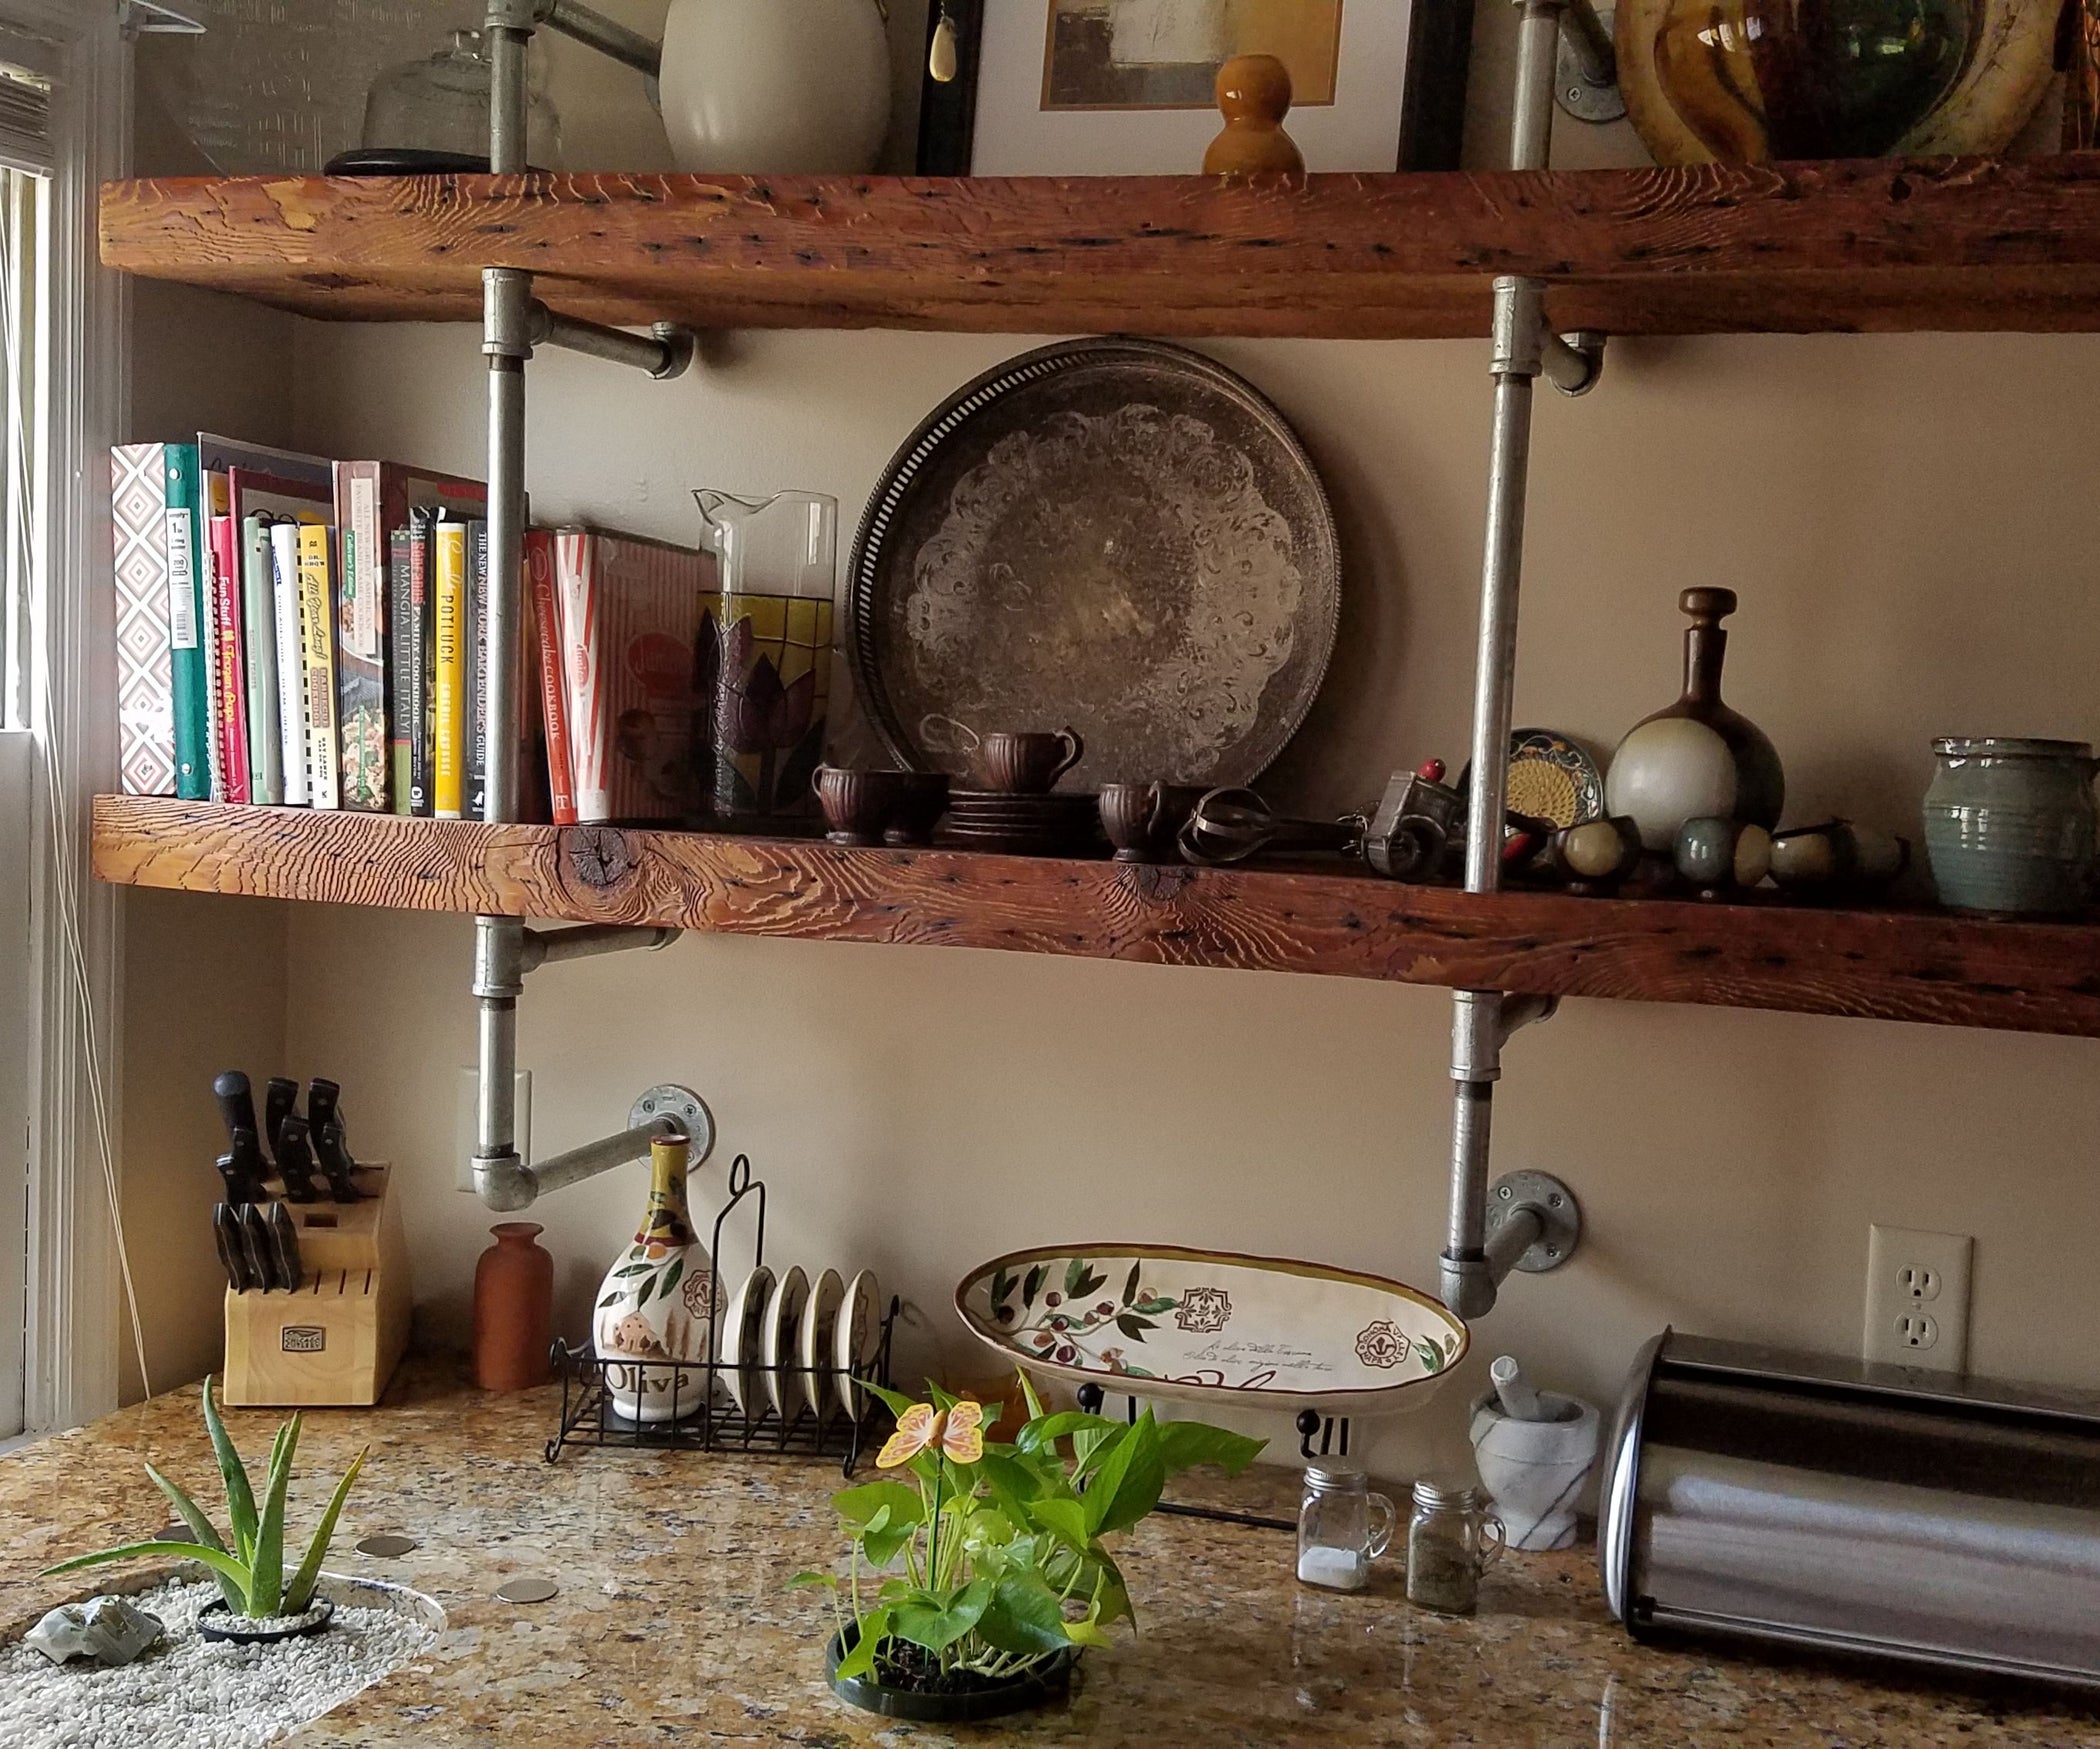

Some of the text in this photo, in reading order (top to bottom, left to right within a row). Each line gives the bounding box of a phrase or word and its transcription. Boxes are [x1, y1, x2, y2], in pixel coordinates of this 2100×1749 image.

[346, 534, 355, 596] Collector's Edition
[478, 532, 487, 553] THE
[478, 553, 487, 576] NEW
[219, 576, 230, 598] Fun
[220, 598, 232, 627] Stuff
[306, 573, 329, 660] All Year Long!
[413, 606, 421, 653] FAMILY
[441, 595, 454, 664] POTLUCK
[478, 607, 488, 643] YORK
[536, 583, 557, 664] Cheesecake
[400, 634, 411, 682] LITTLE
[223, 692, 237, 724] Pops
[311, 667, 321, 728] COOKBOOK
[320, 667, 330, 729] BARBECUE
[400, 689, 411, 734] ITALY!
[413, 655, 421, 725] COOKBOOK
[545, 665, 561, 741] COOKBOOK
[475, 735, 485, 767] GUIDE
[605, 1364, 689, 1394] Oliva
